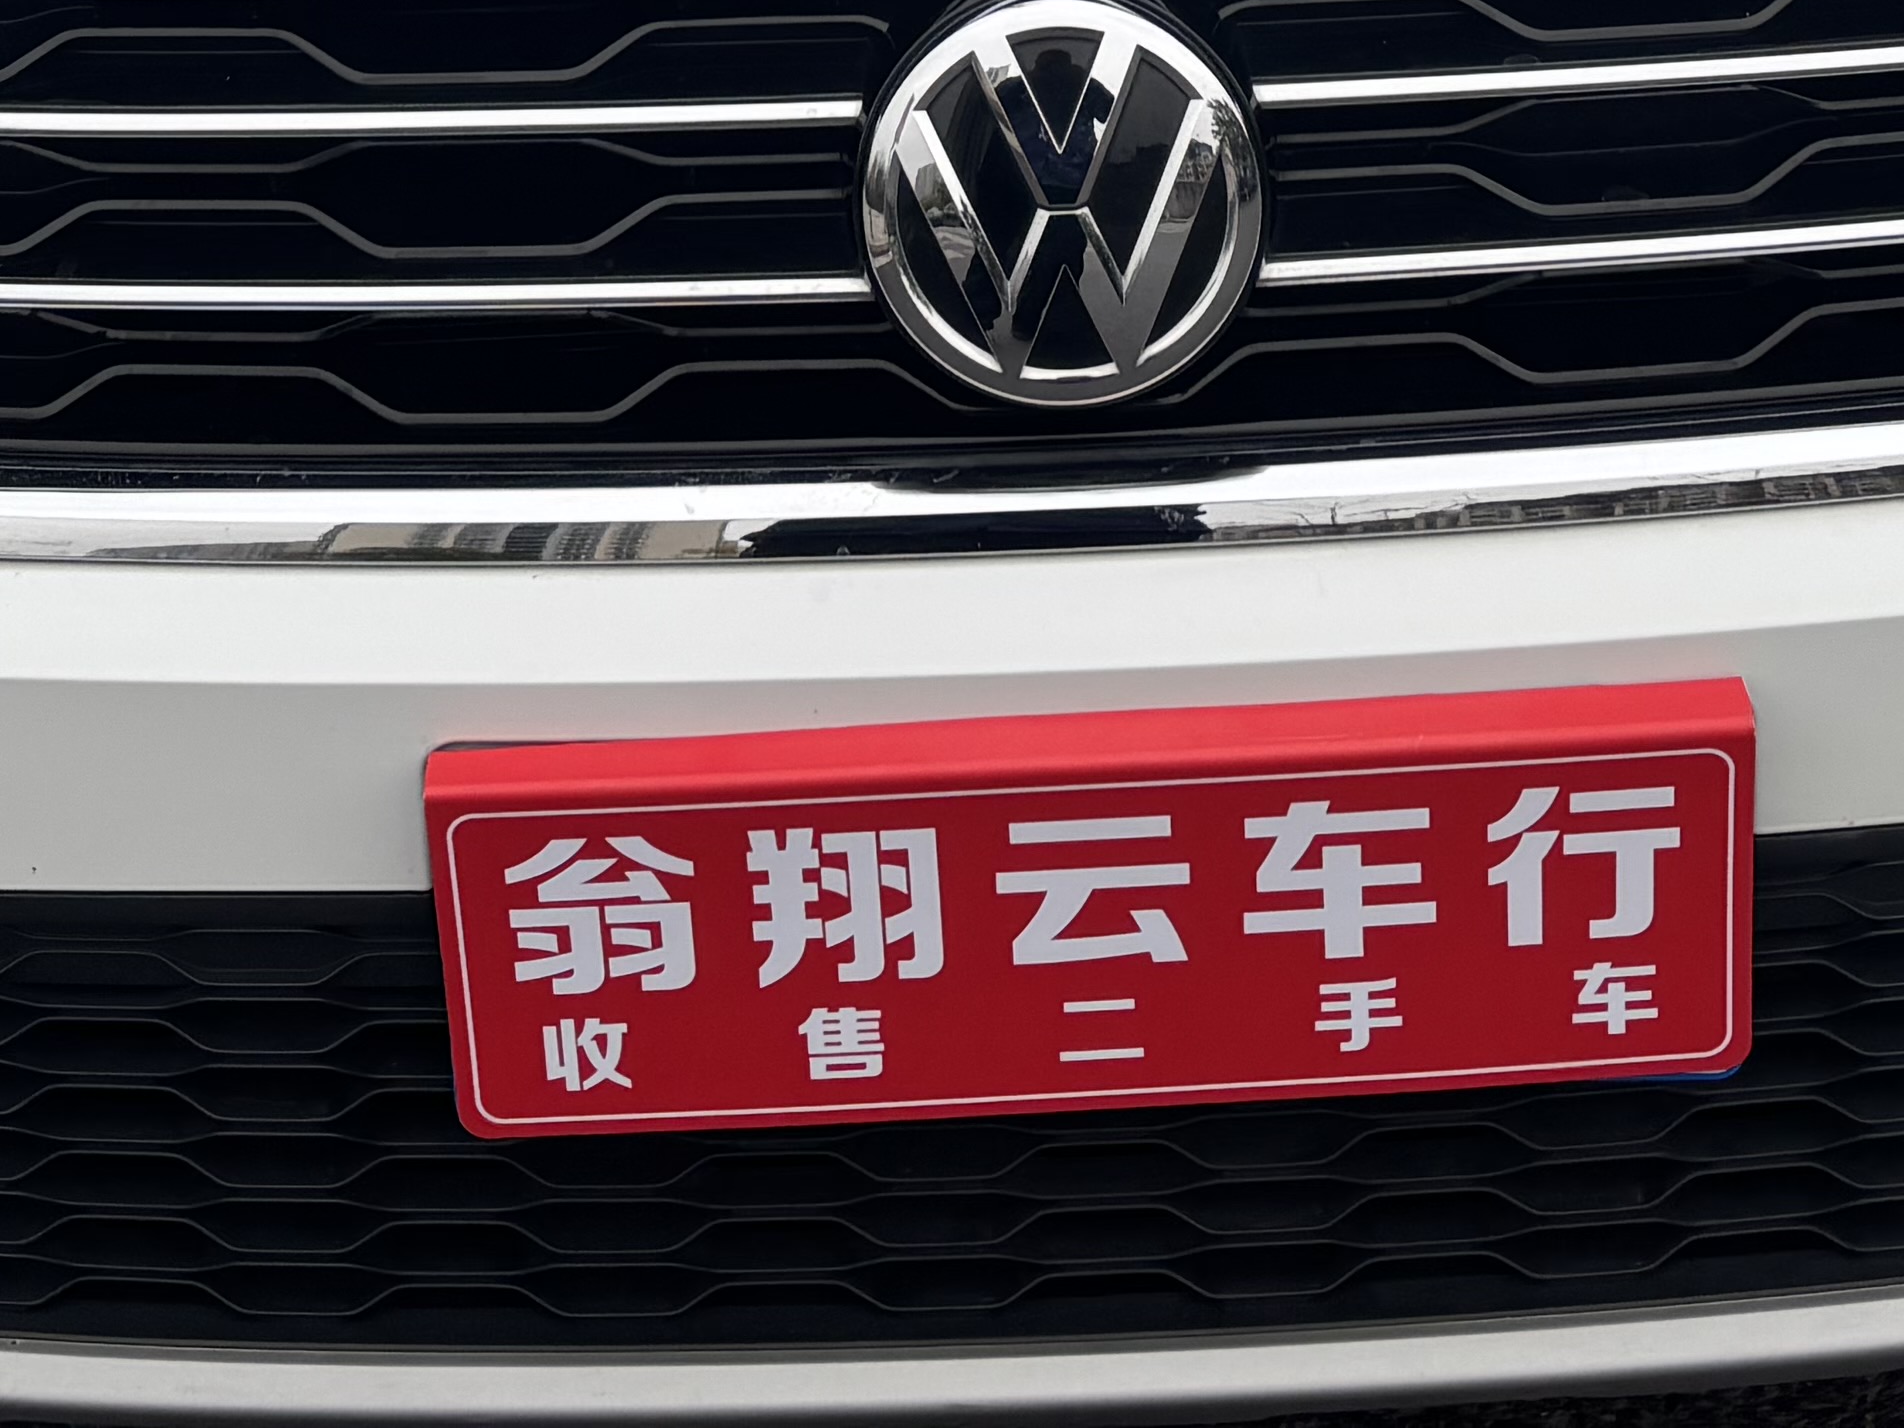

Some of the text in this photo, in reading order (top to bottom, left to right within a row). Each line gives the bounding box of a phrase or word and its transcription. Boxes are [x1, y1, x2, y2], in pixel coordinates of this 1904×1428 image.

[504, 786, 1681, 995] 翁翔云车行
[542, 962, 1659, 1092] 收售二手车
